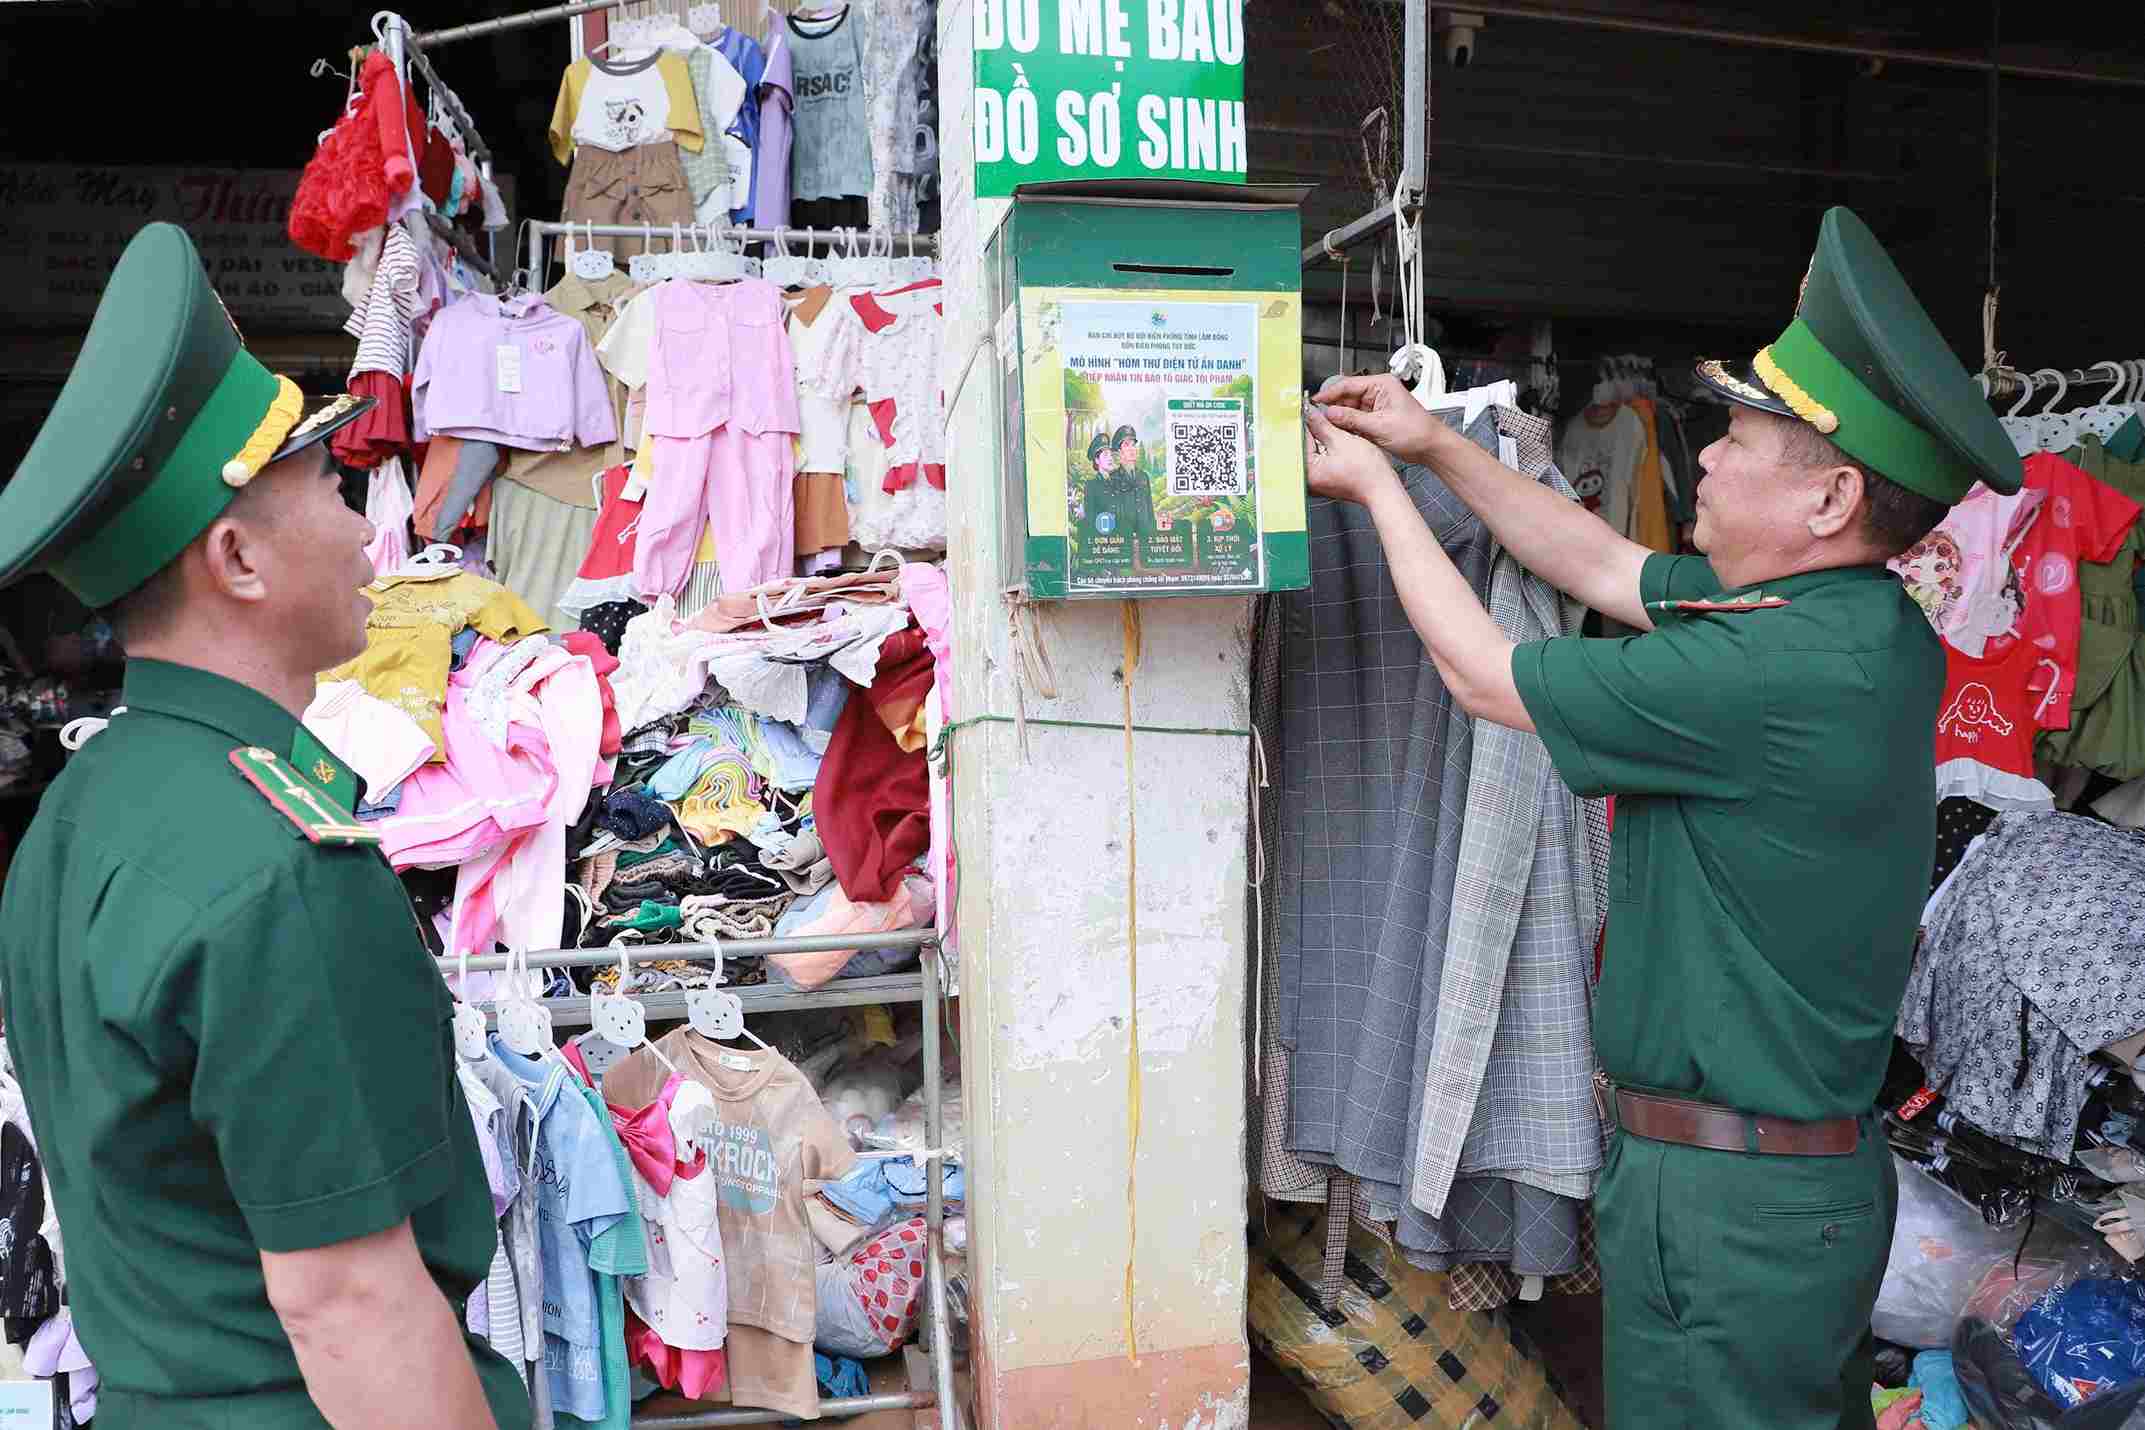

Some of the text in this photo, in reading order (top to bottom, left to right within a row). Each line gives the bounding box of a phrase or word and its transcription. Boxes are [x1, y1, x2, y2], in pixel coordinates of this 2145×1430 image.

[974, 63, 1248, 173] ĐỒ SƠ SINH
[729, 1125, 758, 1144] 1999
